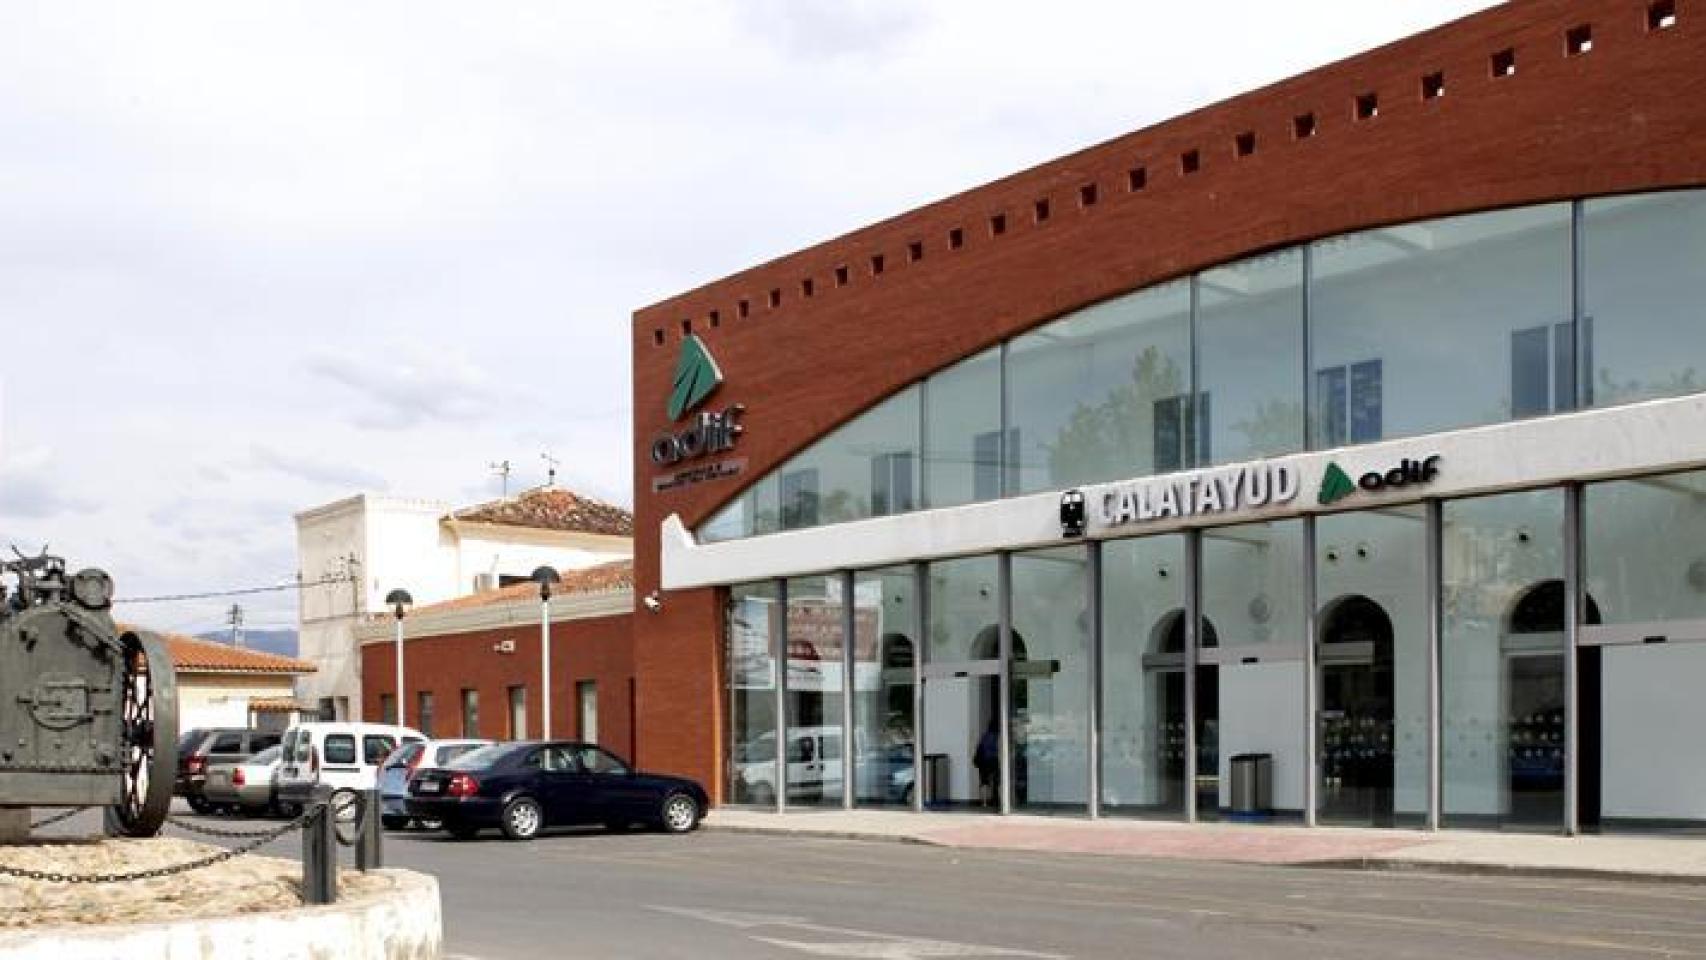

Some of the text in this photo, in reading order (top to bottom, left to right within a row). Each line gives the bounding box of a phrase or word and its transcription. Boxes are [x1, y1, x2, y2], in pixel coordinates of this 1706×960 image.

[652, 404, 744, 464] adif
[1102, 464, 1299, 524] CALATAYUD
[1358, 454, 1441, 490] adif
